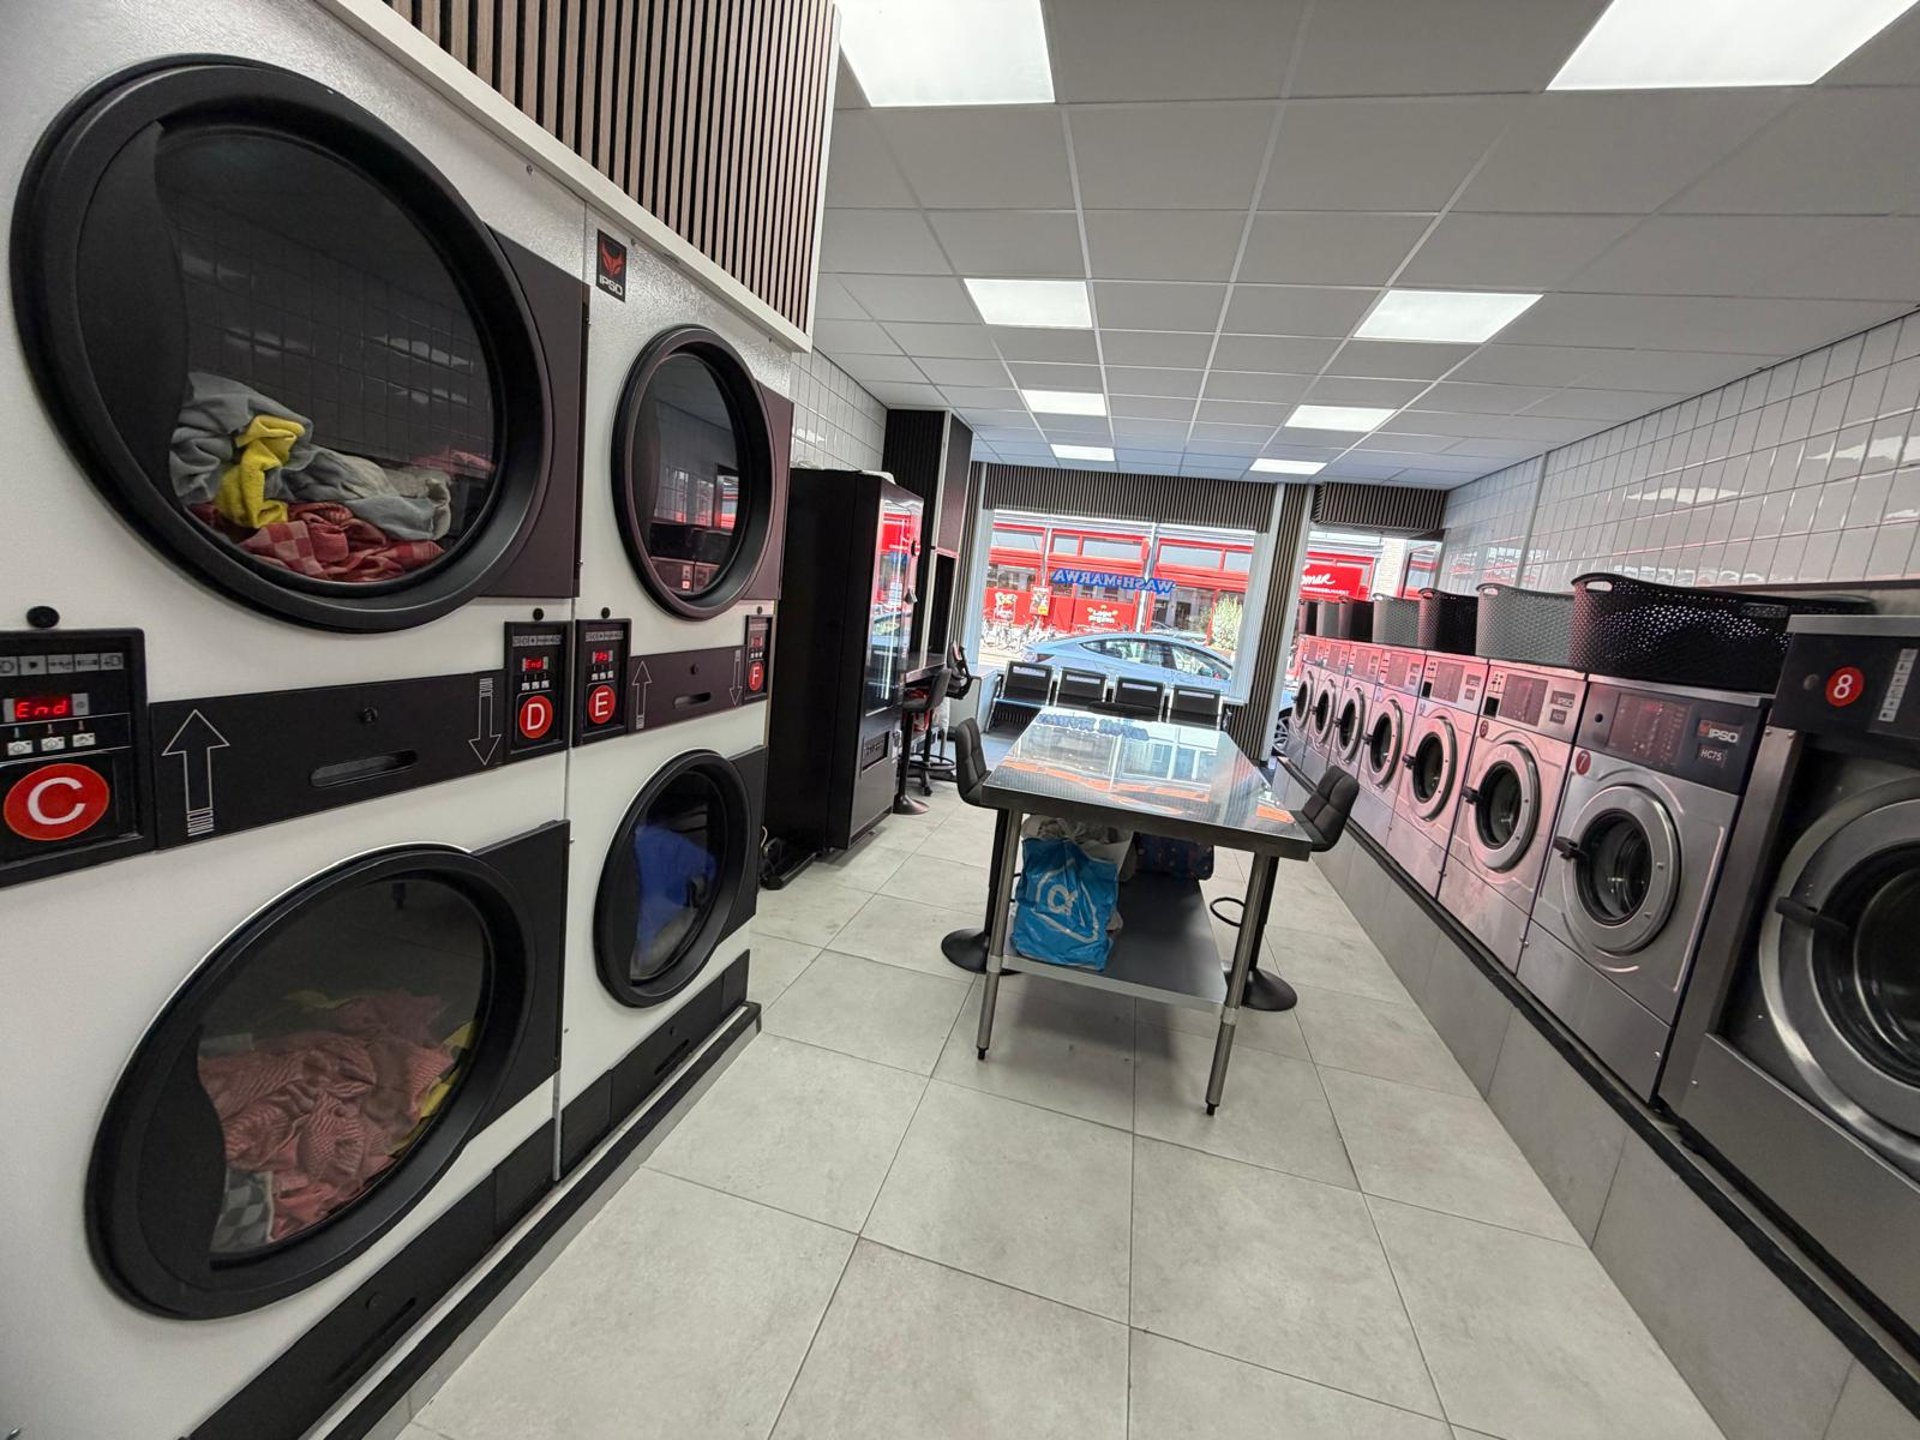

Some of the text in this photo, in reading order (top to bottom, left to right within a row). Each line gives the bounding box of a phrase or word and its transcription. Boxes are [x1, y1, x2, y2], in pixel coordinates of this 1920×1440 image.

[599, 274, 623, 296] IPSO
[751, 666, 761, 685] F
[1834, 673, 1854, 700] 8
[17, 700, 67, 718] End
[595, 691, 610, 717] E
[527, 702, 546, 731] D
[1708, 728, 1739, 744] IPSO
[1579, 753, 1587, 770] 7
[1700, 748, 1723, 761] HC75
[26, 776, 86, 826] C
